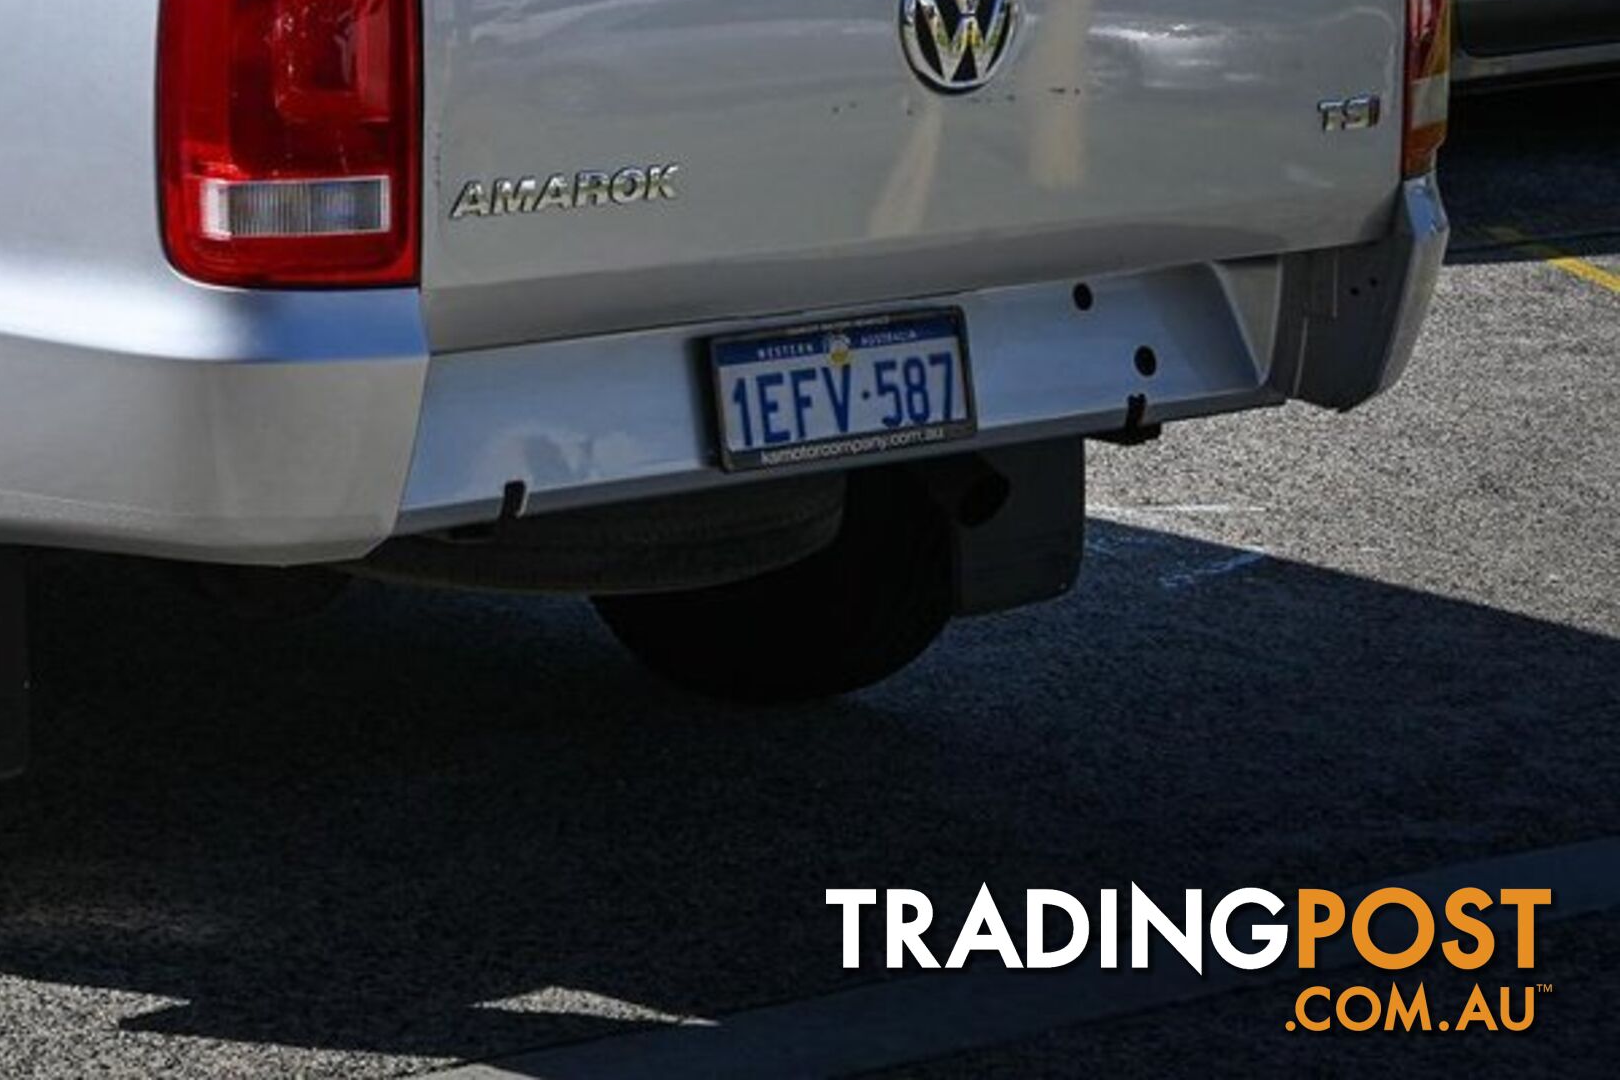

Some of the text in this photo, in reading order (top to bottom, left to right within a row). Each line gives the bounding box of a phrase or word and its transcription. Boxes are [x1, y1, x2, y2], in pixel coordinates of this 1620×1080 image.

[449, 162, 680, 219] AMAROK
[756, 328, 918, 361] WESTERN AUSTRALIA
